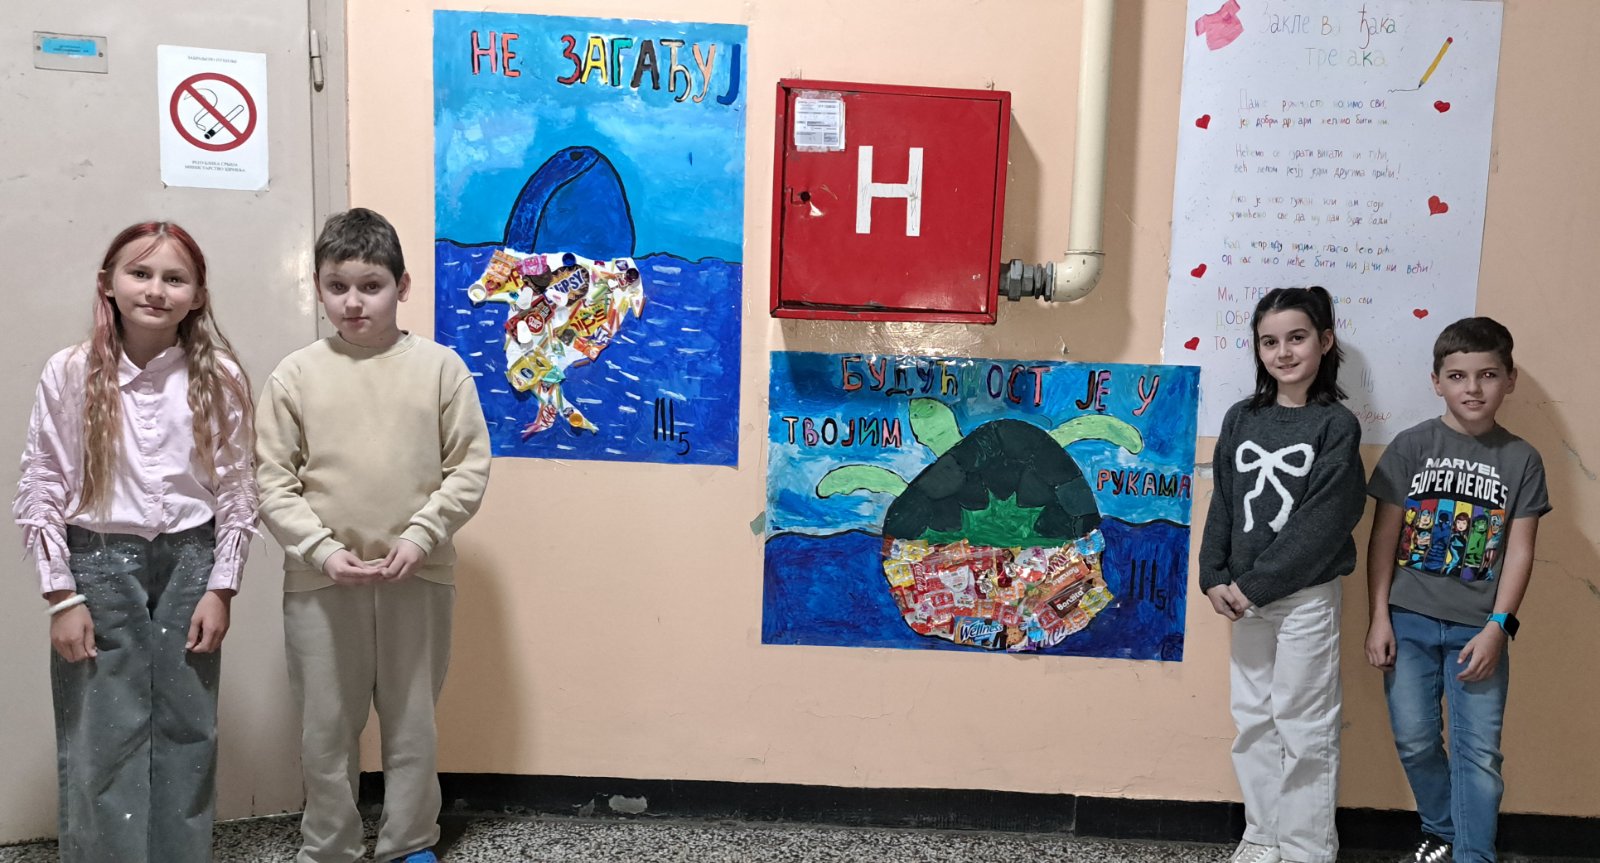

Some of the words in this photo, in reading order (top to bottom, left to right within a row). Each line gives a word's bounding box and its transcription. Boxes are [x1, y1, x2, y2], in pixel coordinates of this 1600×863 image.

[470, 30, 521, 78] НЕ
[557, 34, 742, 106] ЗАГАЂУЈ
[1314, 254, 1337, 270] бити
[1074, 368, 1111, 413] ЈЕ
[1130, 372, 1160, 417] У
[782, 414, 904, 449] ТВОЈИМ
[1096, 468, 1194, 500] РУКАМА
[1425, 457, 1501, 479] MARVEL
[1408, 469, 1455, 497] SUPER
[1455, 471, 1509, 510] HEROES
[960, 619, 1004, 642] Wellness
